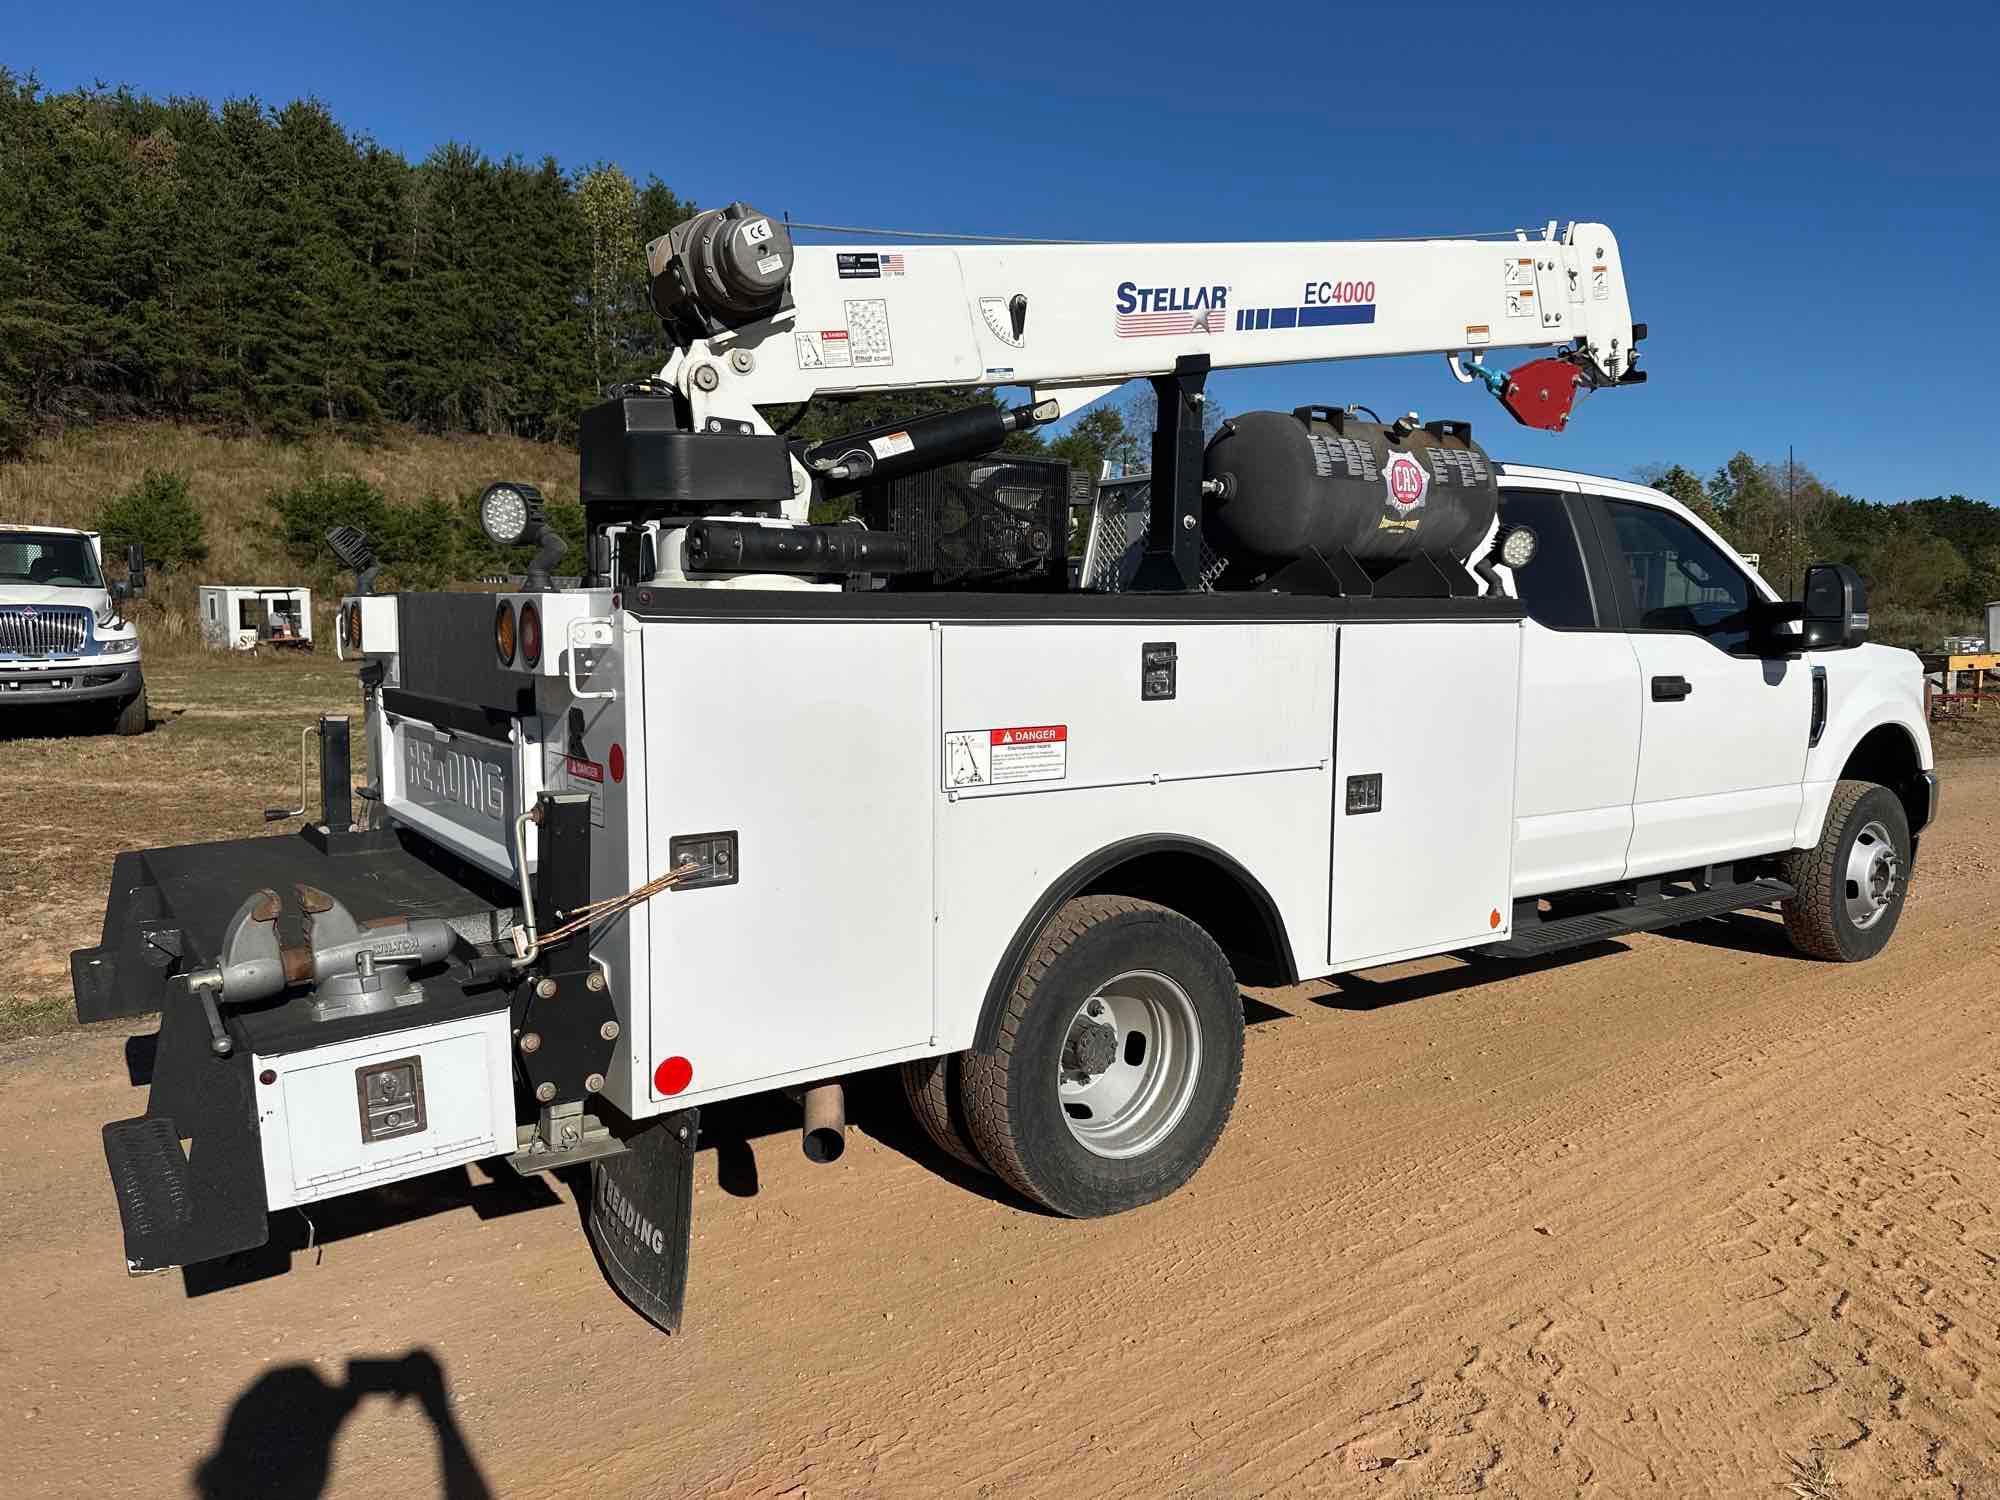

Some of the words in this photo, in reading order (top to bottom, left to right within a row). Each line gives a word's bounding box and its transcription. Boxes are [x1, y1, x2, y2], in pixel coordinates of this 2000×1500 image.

[750, 225, 766, 239] CE
[1116, 281, 1228, 314] STELLAR
[1304, 281, 1376, 304] EC4000
[1395, 466, 1418, 492] CAS
[1015, 730, 1056, 741] DANGER
[408, 740, 504, 819] READING
[606, 1178, 663, 1255] READING
